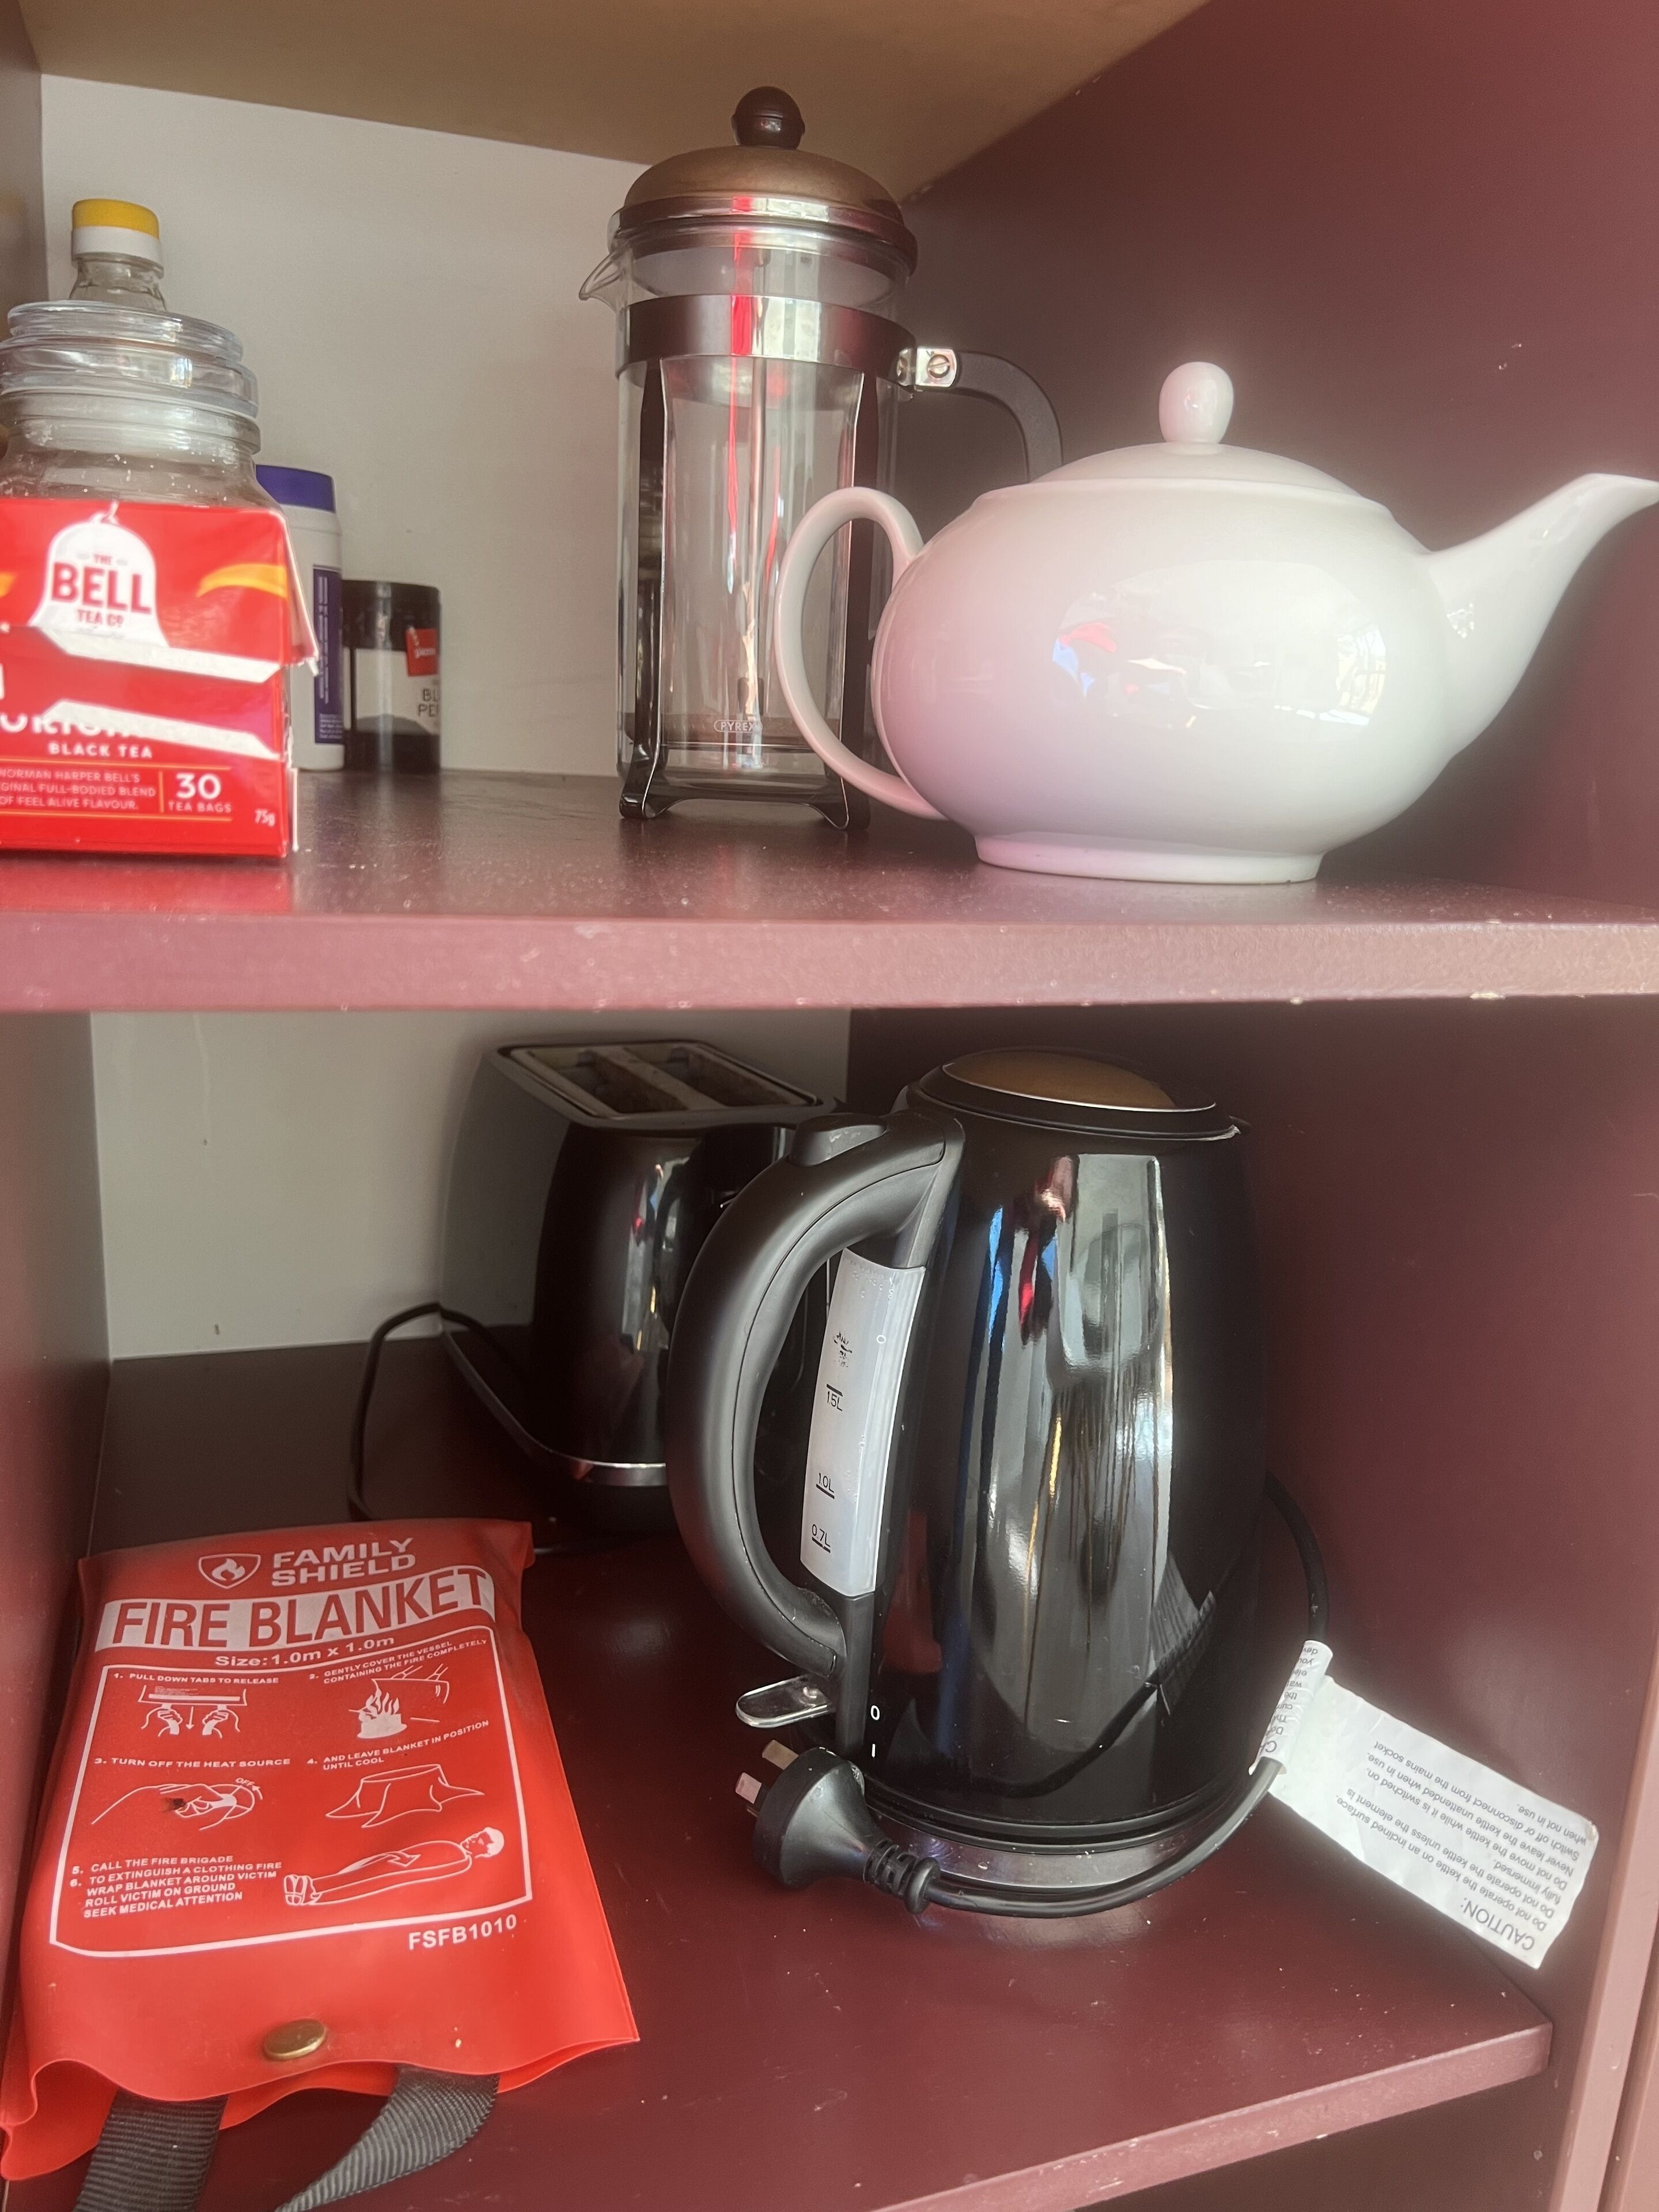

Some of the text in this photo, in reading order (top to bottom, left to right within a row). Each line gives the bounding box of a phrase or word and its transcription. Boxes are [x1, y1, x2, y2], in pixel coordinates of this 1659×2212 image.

[93, 554, 112, 565] THE
[51, 562, 152, 615] BELL
[77, 609, 103, 624] TEA
[720, 721, 755, 732] PYREX
[48, 742, 151, 757] BLACK TEA
[54, 771, 101, 781] HARPER
[176, 772, 221, 800] 30
[0, 795, 14, 805] OF
[16, 796, 45, 806] FEEL
[47, 797, 79, 808] ALIVE
[118, 786, 156, 797] BLEND
[168, 801, 232, 813] TEA BAGS
[254, 808, 275, 826] 75g
[811, 1524, 831, 1548] 0.7L
[273, 1537, 412, 1568] FAMILY
[271, 1555, 415, 1586] SHIELD
[112, 1571, 487, 1647] FIRE BLANKET
[324, 1664, 361, 1677] GENTLY
[362, 1656, 395, 1668] COVER
[396, 1651, 415, 1664] THE
[416, 1641, 452, 1655] VESSEL
[327, 1647, 339, 1657] x
[345, 1637, 394, 1652] 1.0m
[323, 1639, 486, 1684] CONTAINING THE FIRE COMPLETELY
[1283, 1691, 1297, 1700] the
[323, 1755, 346, 1763] AND
[347, 1749, 380, 1760] LEAVE
[382, 1738, 430, 1754] BLANKET
[431, 1735, 441, 1744] IN
[443, 1719, 489, 1740] POSITION
[111, 1758, 145, 1766] TURN
[239, 1758, 290, 1767] SOURCE
[323, 1757, 384, 1770] UNTIL COOL
[235, 1777, 255, 1787] OFF
[1373, 1741, 1580, 1861] Switch off or disconnect from the mains socket
[1367, 1752, 1574, 1877] Never leave the kettle unattended when in use.
[1517, 1804, 1587, 1846] when not in use.
[1366, 1768, 1568, 1891] Do not move the kettle while it is switched on.
[71, 1855, 233, 1874] 5. CALL THE FIRE BRIGADE
[1336, 1795, 1547, 1931] Do not operate the kettle on an inclined surface.
[1346, 1788, 1555, 1919] Do not operate the kettle unless the element is
[87, 1870, 276, 1896] WRAP BLANKET AROUND VICTIM
[89, 1875, 105, 1885] TO
[108, 1867, 180, 1882] EXTINGUISH
[193, 1863, 253, 1873] CLOTHING
[256, 1861, 282, 1870] FIRE
[1493, 1859, 1561, 1905] fully immersed.
[84, 1891, 243, 1918] SEEK MEDICAL ATTENTION
[85, 1882, 236, 1907] ROLL VICTIM ON GROUND
[408, 1914, 517, 1950] FSFB1010
[1460, 1897, 1535, 1950] CAUTION:
